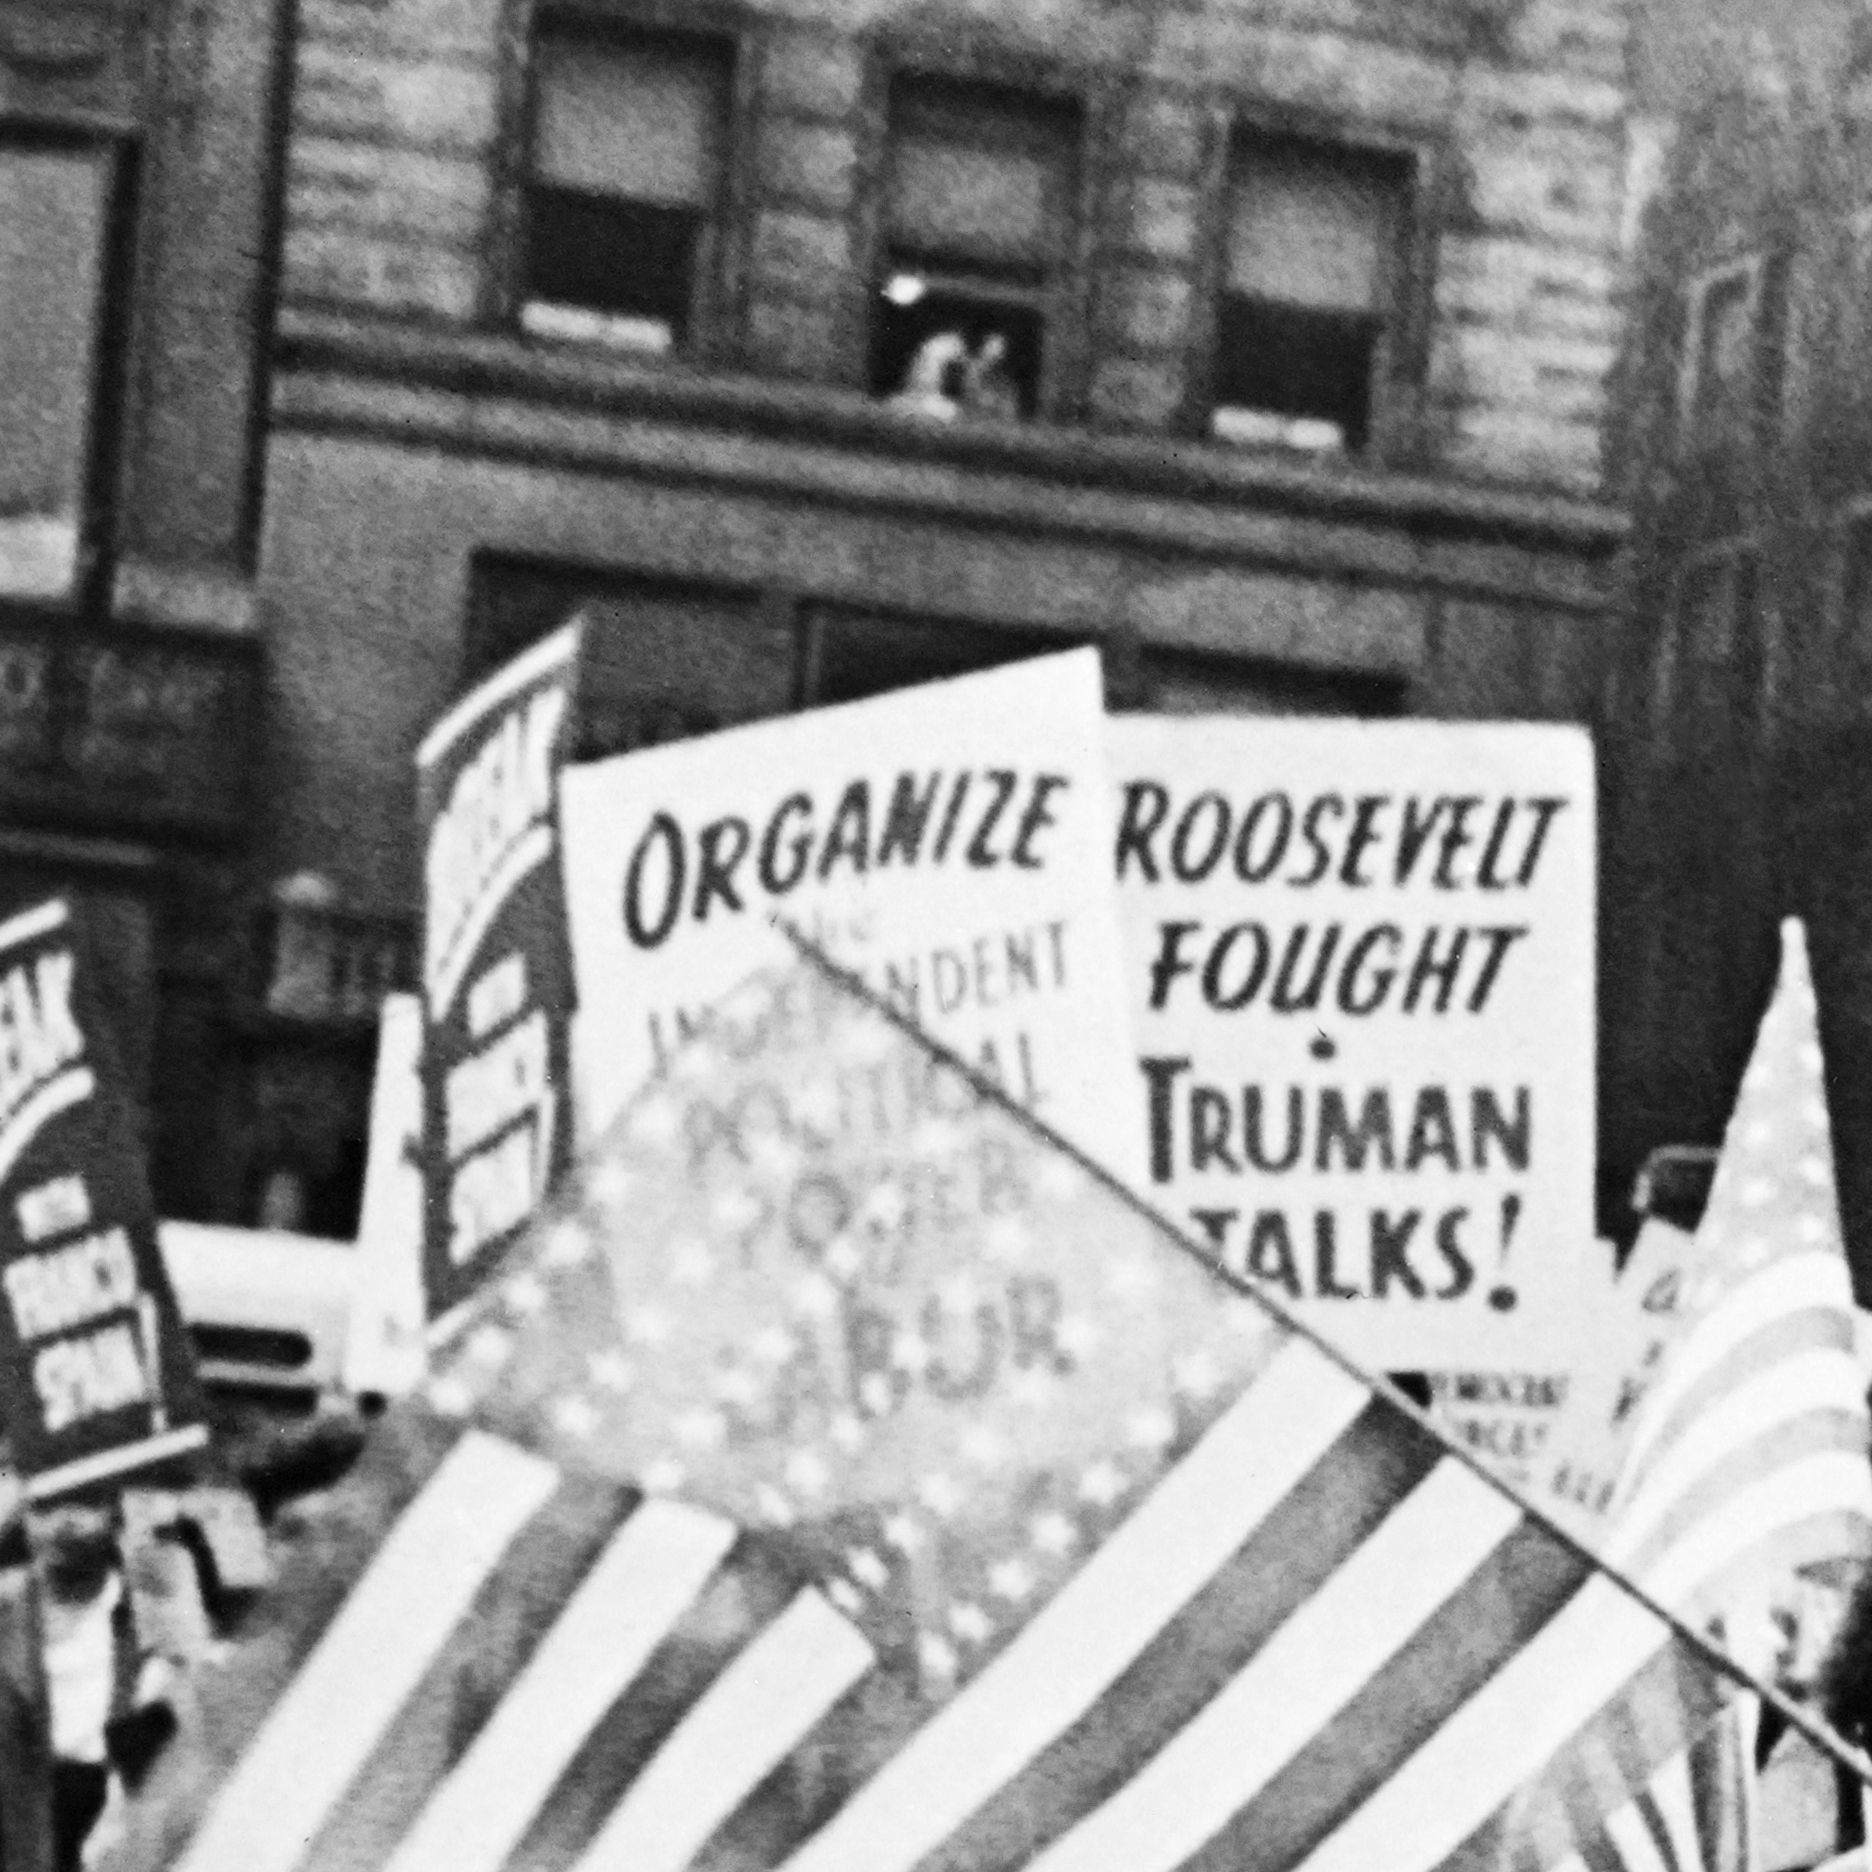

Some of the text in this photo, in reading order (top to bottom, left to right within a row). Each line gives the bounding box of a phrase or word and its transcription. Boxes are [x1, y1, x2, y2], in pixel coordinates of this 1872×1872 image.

[622, 769, 1071, 951] ORGANIZE
[1114, 776, 1571, 890] ROOSEVELT
[1148, 917, 1531, 1017] FOUGHT
[1138, 1056, 1533, 1185] TRUMAN
[1188, 1193, 1524, 1313] TALKS!
